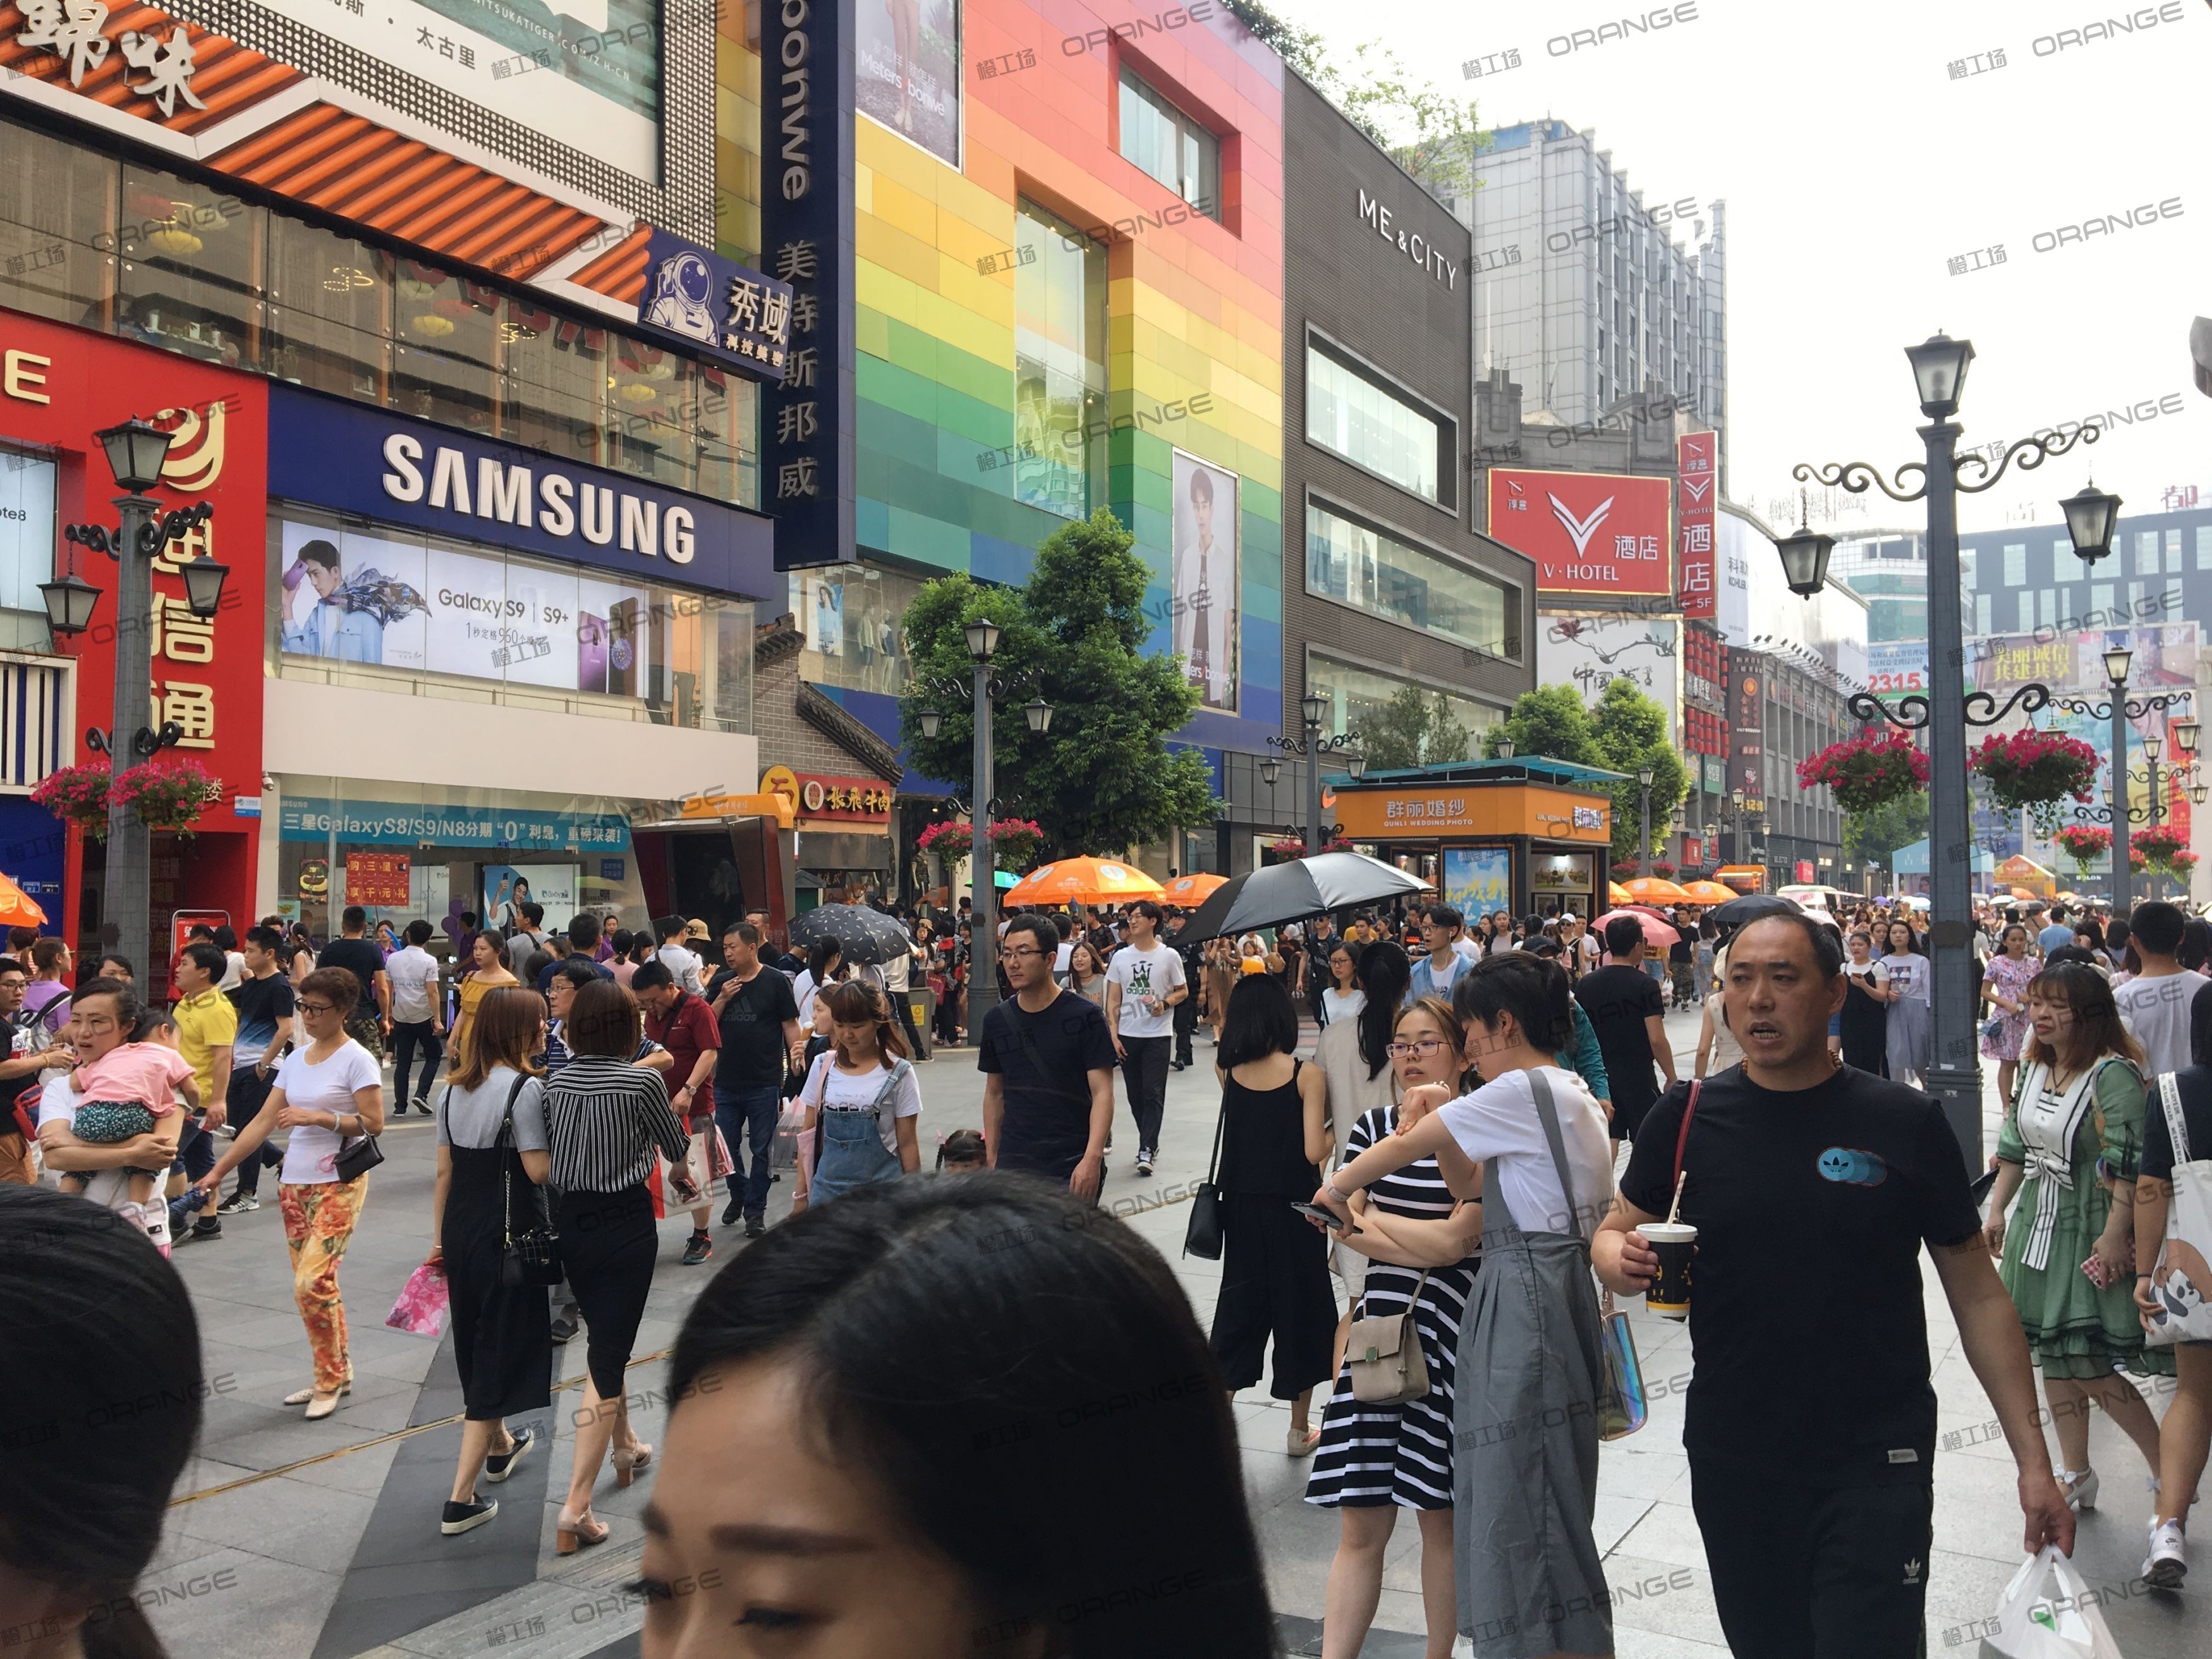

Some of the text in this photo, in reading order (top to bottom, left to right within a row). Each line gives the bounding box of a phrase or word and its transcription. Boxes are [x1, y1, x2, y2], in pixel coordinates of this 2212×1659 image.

[329, 0, 476, 70] 斯 太古里
[727, 276, 790, 346] 秀域
[726, 333, 785, 368] 科技美容
[382, 433, 695, 565] SAMSUNG
[2161, 484, 2199, 513] 都
[1614, 535, 1659, 561] 酒店
[1682, 523, 1711, 593] 酒店
[438, 588, 569, 624] Galaxy S9 S9+
[1696, 597, 1713, 609] 5F
[1995, 643, 2071, 665] 美丽诚信
[826, 785, 891, 814] 张飞牛肉
[1386, 798, 1466, 818] 群丽婚纱
[1447, 818, 1473, 827] PHOTO
[349, 860, 392, 873] 购三星
[349, 885, 407, 899] 享千元礼
